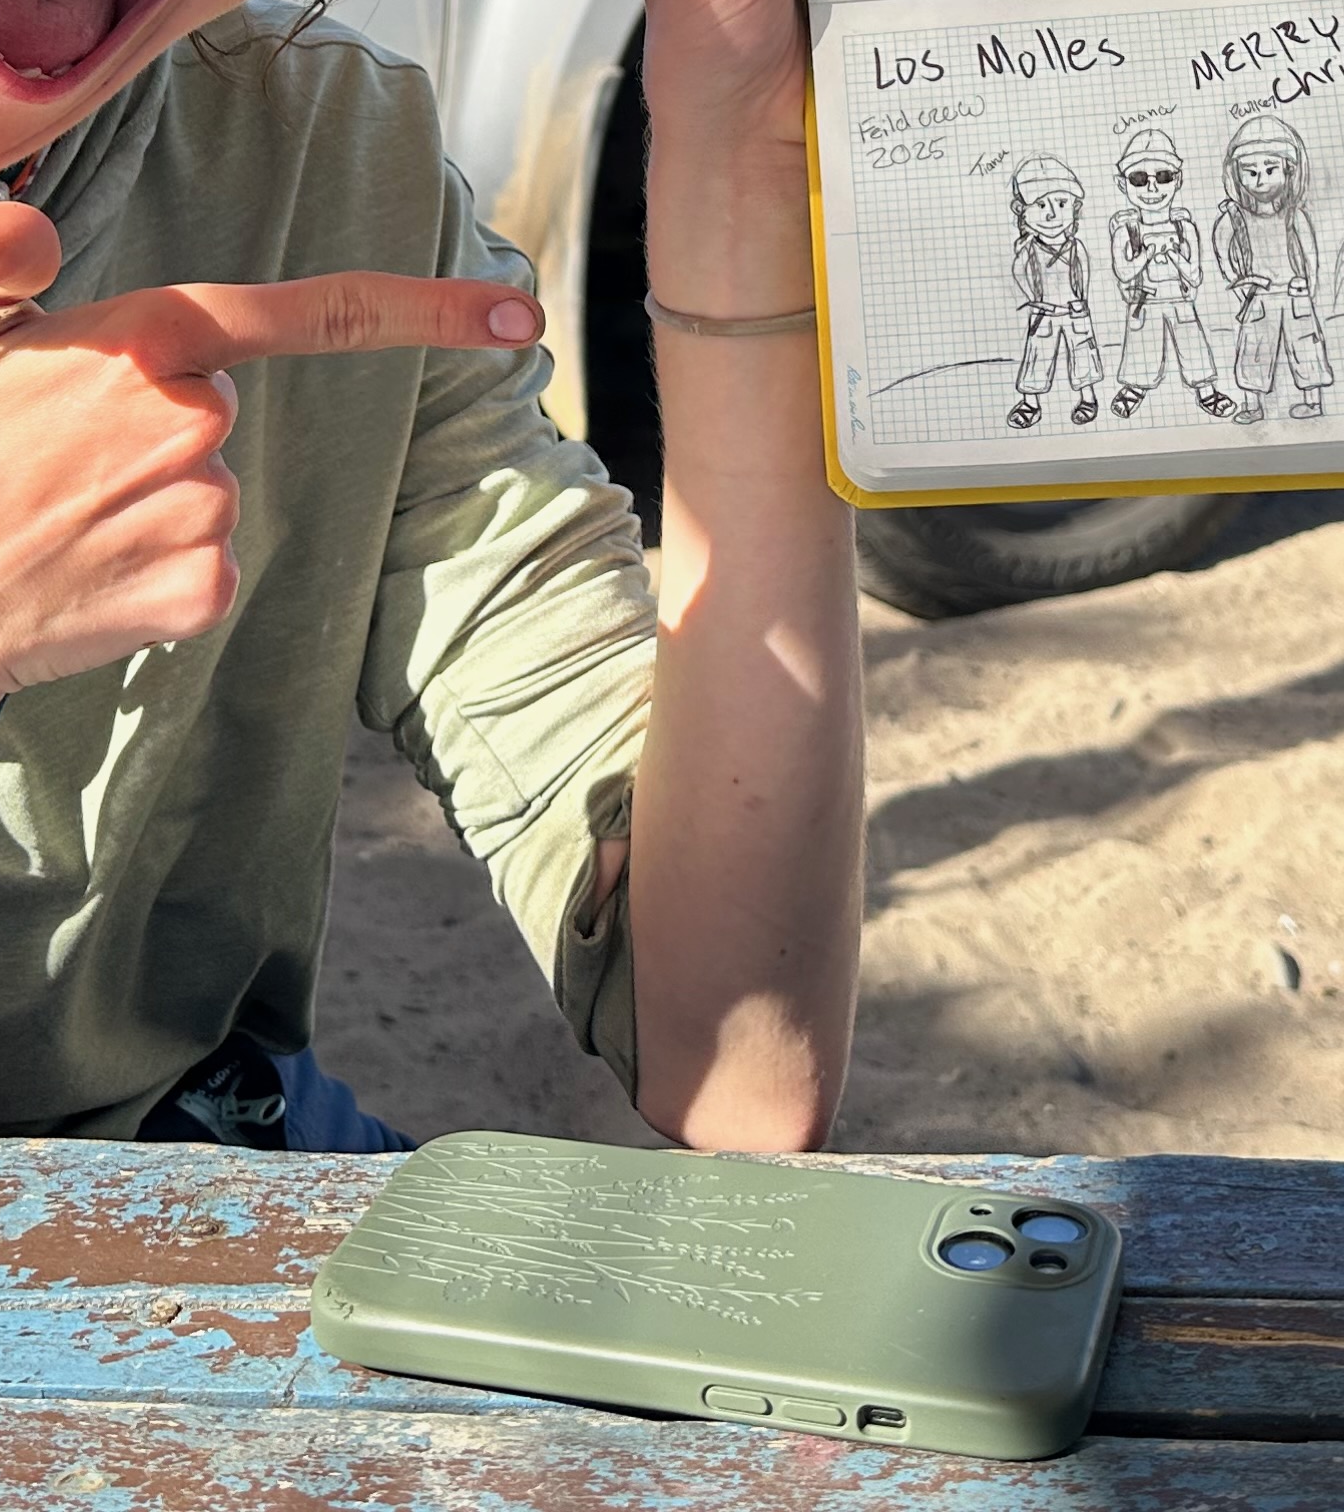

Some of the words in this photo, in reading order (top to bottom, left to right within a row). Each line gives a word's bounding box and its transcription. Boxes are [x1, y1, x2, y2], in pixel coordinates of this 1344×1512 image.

[977, 27, 1126, 80] Molles
[1191, 15, 1341, 90] MERRY
[866, 136, 947, 169] 2025
